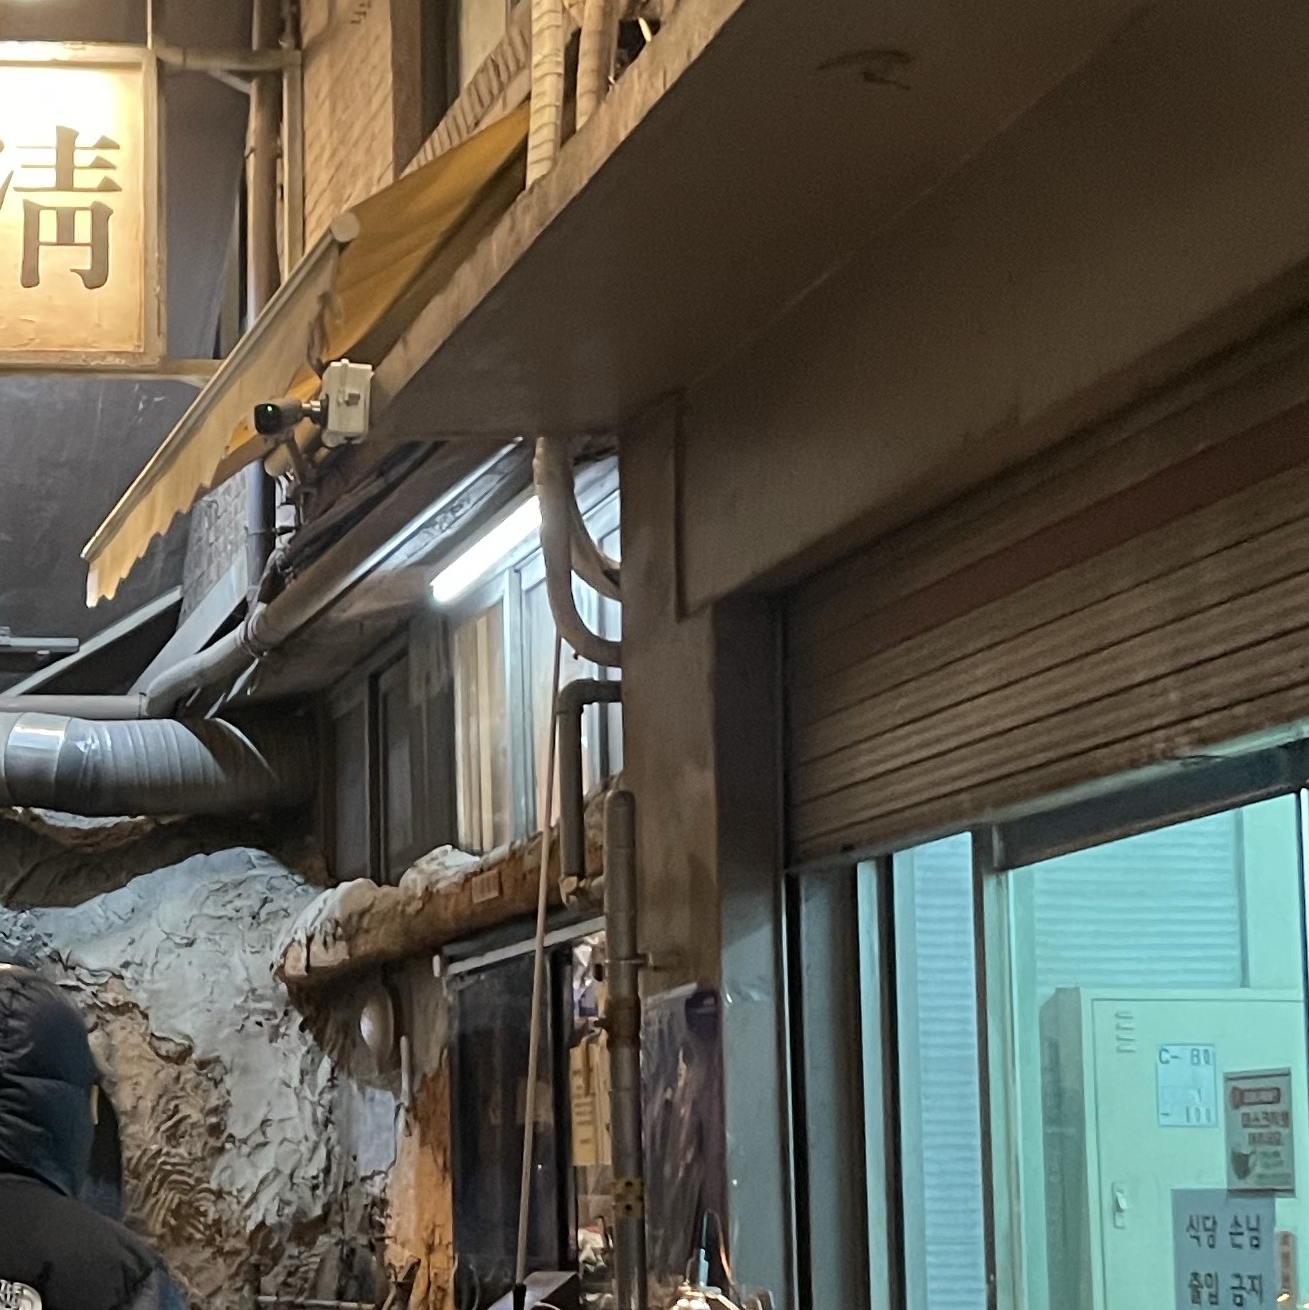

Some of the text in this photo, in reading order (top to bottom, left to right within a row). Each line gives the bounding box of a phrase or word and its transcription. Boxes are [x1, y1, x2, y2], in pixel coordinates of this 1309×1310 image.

[1186, 1214, 1261, 1250] 식당 손님
[1188, 1269, 1264, 1307] 출입 금지
